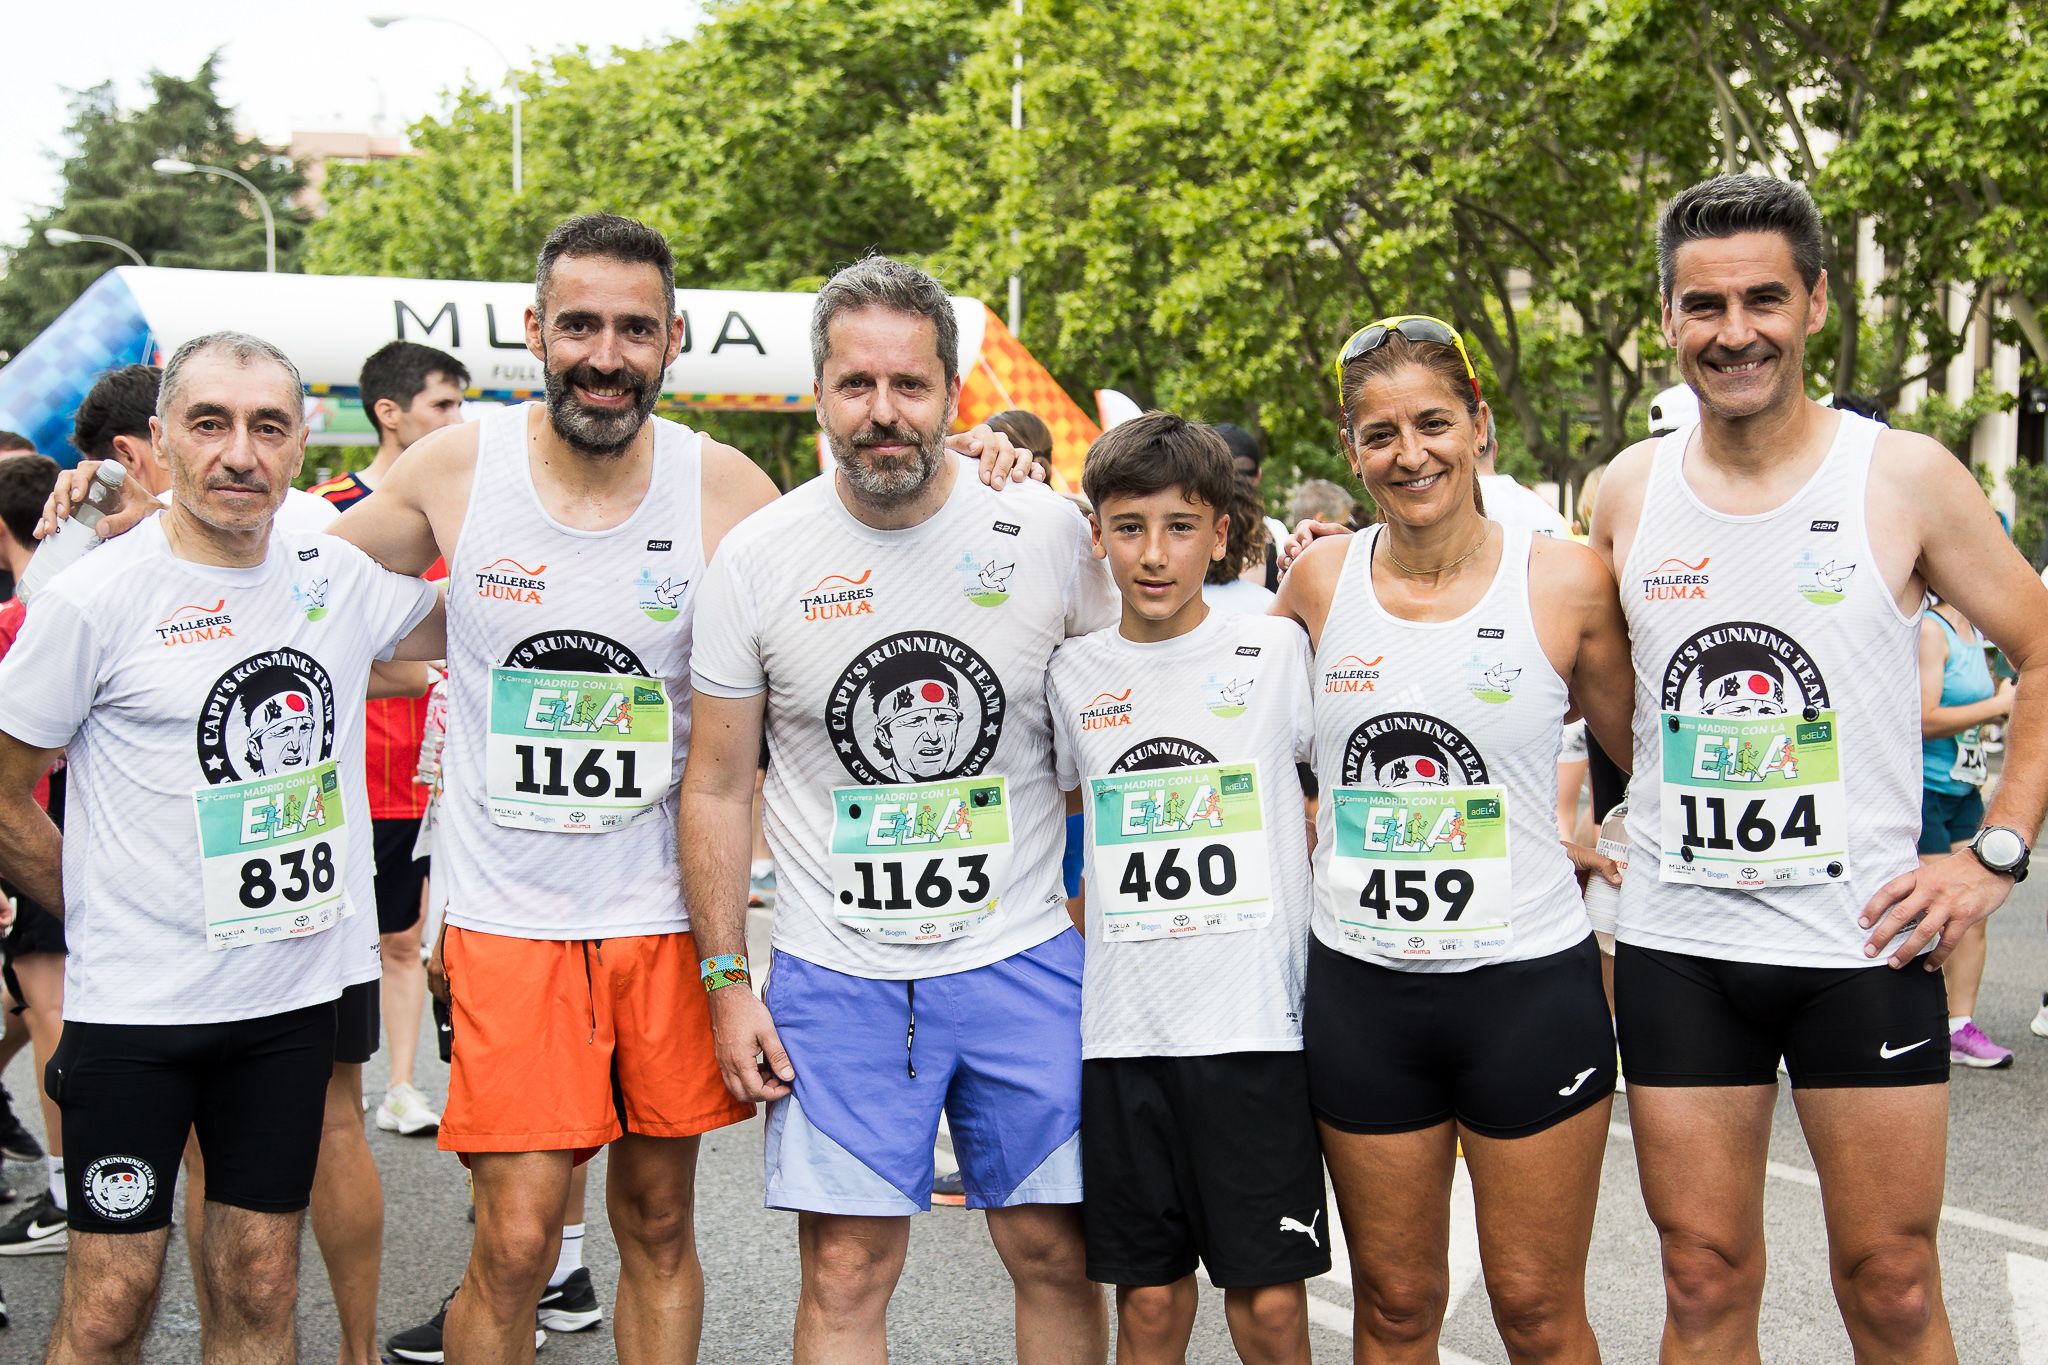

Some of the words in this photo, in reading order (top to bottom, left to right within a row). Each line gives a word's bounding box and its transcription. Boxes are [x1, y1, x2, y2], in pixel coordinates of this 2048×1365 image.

[994, 523, 1019, 534] 42K
[1812, 522, 1837, 530] 42K
[648, 541, 670, 549] 42K
[476, 573, 546, 590] TALLERES
[1643, 575, 1709, 593] TALLERES
[479, 584, 543, 605] JUMA
[800, 588, 874, 612] TALLERES
[1645, 586, 1706, 600] JUMA
[805, 600, 873, 621] JUMA
[156, 615, 232, 639] TALLERES
[164, 625, 236, 647] JUMA
[1479, 629, 1503, 638] 42K
[531, 635, 630, 665] RUNNING
[1236, 647, 1259, 656] 42K
[1696, 627, 1794, 659] RUNNING
[506, 675, 531, 684] Carrera
[534, 678, 580, 689] MADRID
[583, 680, 606, 690] CON
[609, 682, 624, 691] LA
[831, 663, 869, 731] CAPI'S
[866, 637, 966, 669] RUNNING
[965, 657, 1000, 716] TEAM
[1324, 680, 1376, 693] JUMA
[1325, 670, 1380, 686] TALLERES
[203, 678, 237, 746] CAPI'S
[232, 652, 312, 683] RUNNING
[313, 666, 333, 721] TEAM
[524, 688, 632, 735] ELA
[1080, 704, 1132, 723] TALLERES
[1082, 714, 1132, 731] JUMA
[1697, 723, 1739, 734] MADRID
[1741, 725, 1767, 736] CON
[1771, 723, 1785, 733] LA
[1800, 732, 1827, 741] adELA
[1124, 742, 1205, 768] RUNNING
[1364, 717, 1459, 747] RUNNING
[1456, 744, 1484, 785] TEA
[1691, 733, 1799, 782] ELA
[515, 745, 642, 798] 1161
[1123, 779, 1166, 790] MADRID
[1168, 775, 1192, 786] CON
[1195, 774, 1210, 783] LA
[213, 792, 240, 801] Carrera
[243, 783, 284, 799] MADRID
[286, 778, 305, 789] CON
[306, 773, 316, 784] LA
[875, 793, 918, 802] MADRID
[920, 791, 944, 800] CON
[947, 788, 960, 796] LA
[1225, 783, 1249, 792] adELA
[1121, 784, 1223, 836] ELA
[1370, 796, 1409, 805] MADRID
[1411, 796, 1437, 806] CON
[1440, 796, 1456, 805] LA
[240, 784, 326, 845] ELA
[866, 797, 972, 846] ELA
[1680, 794, 1821, 853] 1164
[1363, 806, 1466, 852] ELA
[239, 842, 335, 909] 838
[1120, 844, 1237, 902] 460
[1668, 863, 1696, 872] MUKUA
[1707, 870, 1729, 879] Biogen
[854, 854, 990, 910] 1163
[1360, 869, 1474, 921] 459
[214, 929, 245, 938] MUKUA
[951, 925, 964, 933] LIFE
[85, 1164, 100, 1188] CAPI'S
[98, 1156, 144, 1168] RUNNING
[142, 1164, 155, 1187] TEAM
